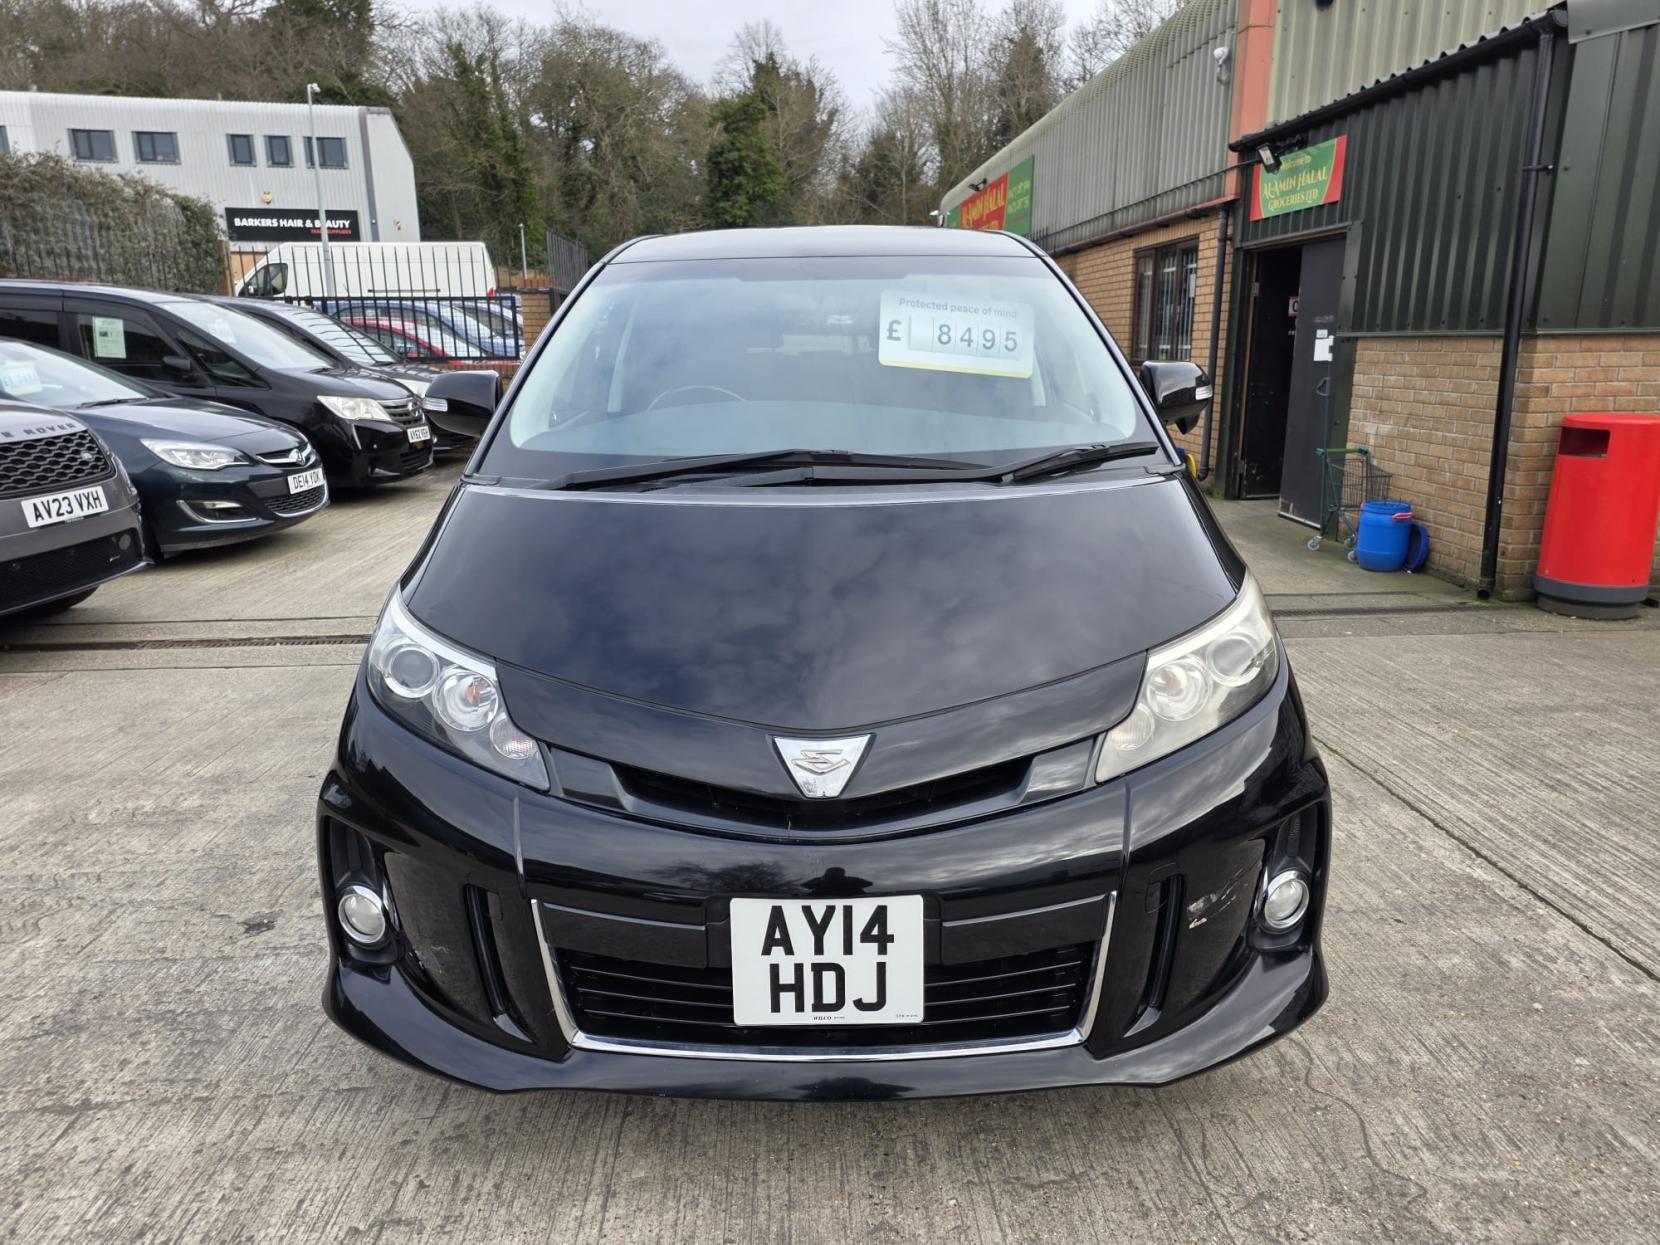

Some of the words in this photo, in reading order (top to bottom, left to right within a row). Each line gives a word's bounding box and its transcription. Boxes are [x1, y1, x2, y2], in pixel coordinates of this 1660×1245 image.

[234, 218, 277, 227] BARKERS
[279, 219, 304, 228] HAIR
[305, 219, 313, 228] &
[314, 219, 350, 229] BAUTY
[899, 297, 948, 311] Protected
[950, 303, 980, 315] peace
[982, 306, 993, 316] of
[994, 308, 1017, 319] mind
[886, 320, 902, 341] £
[937, 323, 1018, 352] 8495
[23, 423, 76, 436] ROVER
[293, 473, 309, 489] DE14
[32, 496, 74, 522] AV23
[74, 490, 103, 512] VXH
[761, 904, 895, 956] AY14
[769, 961, 887, 1013] HDJ
